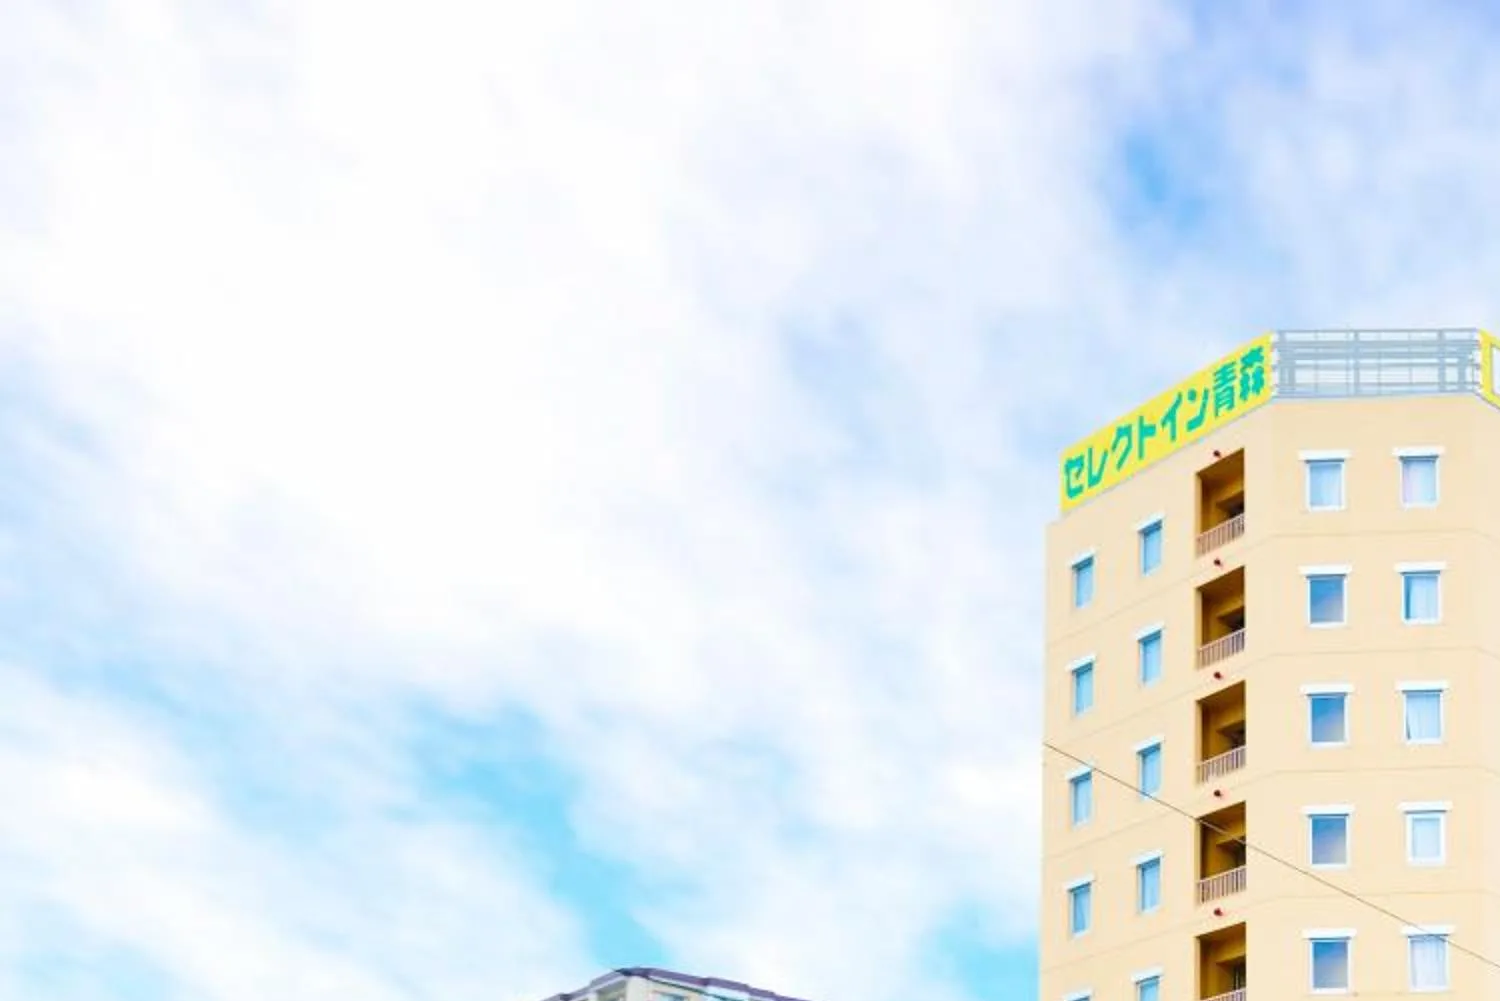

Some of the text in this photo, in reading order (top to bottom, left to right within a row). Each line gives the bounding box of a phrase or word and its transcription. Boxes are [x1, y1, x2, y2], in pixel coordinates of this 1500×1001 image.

[1064, 345, 1265, 499] セレクトイン青森
